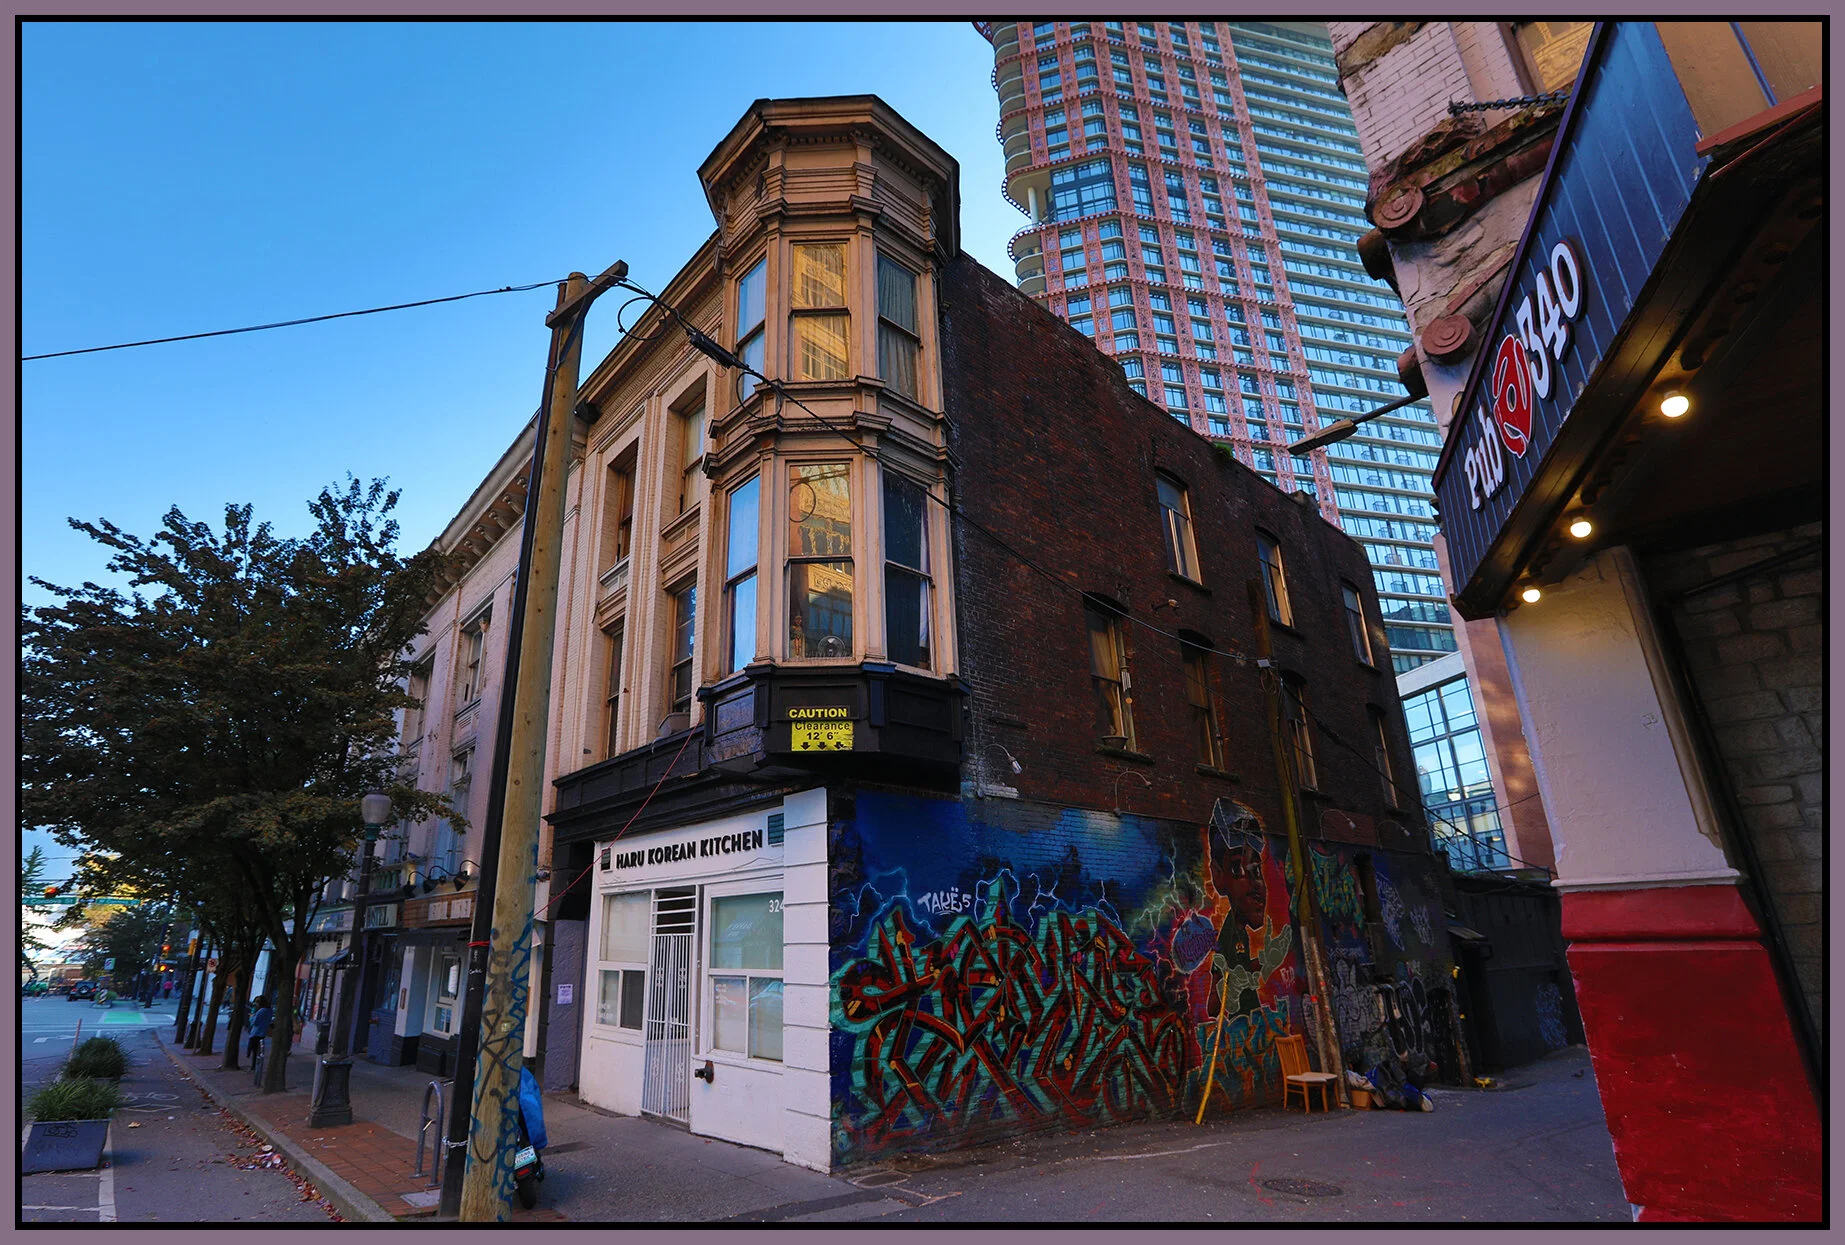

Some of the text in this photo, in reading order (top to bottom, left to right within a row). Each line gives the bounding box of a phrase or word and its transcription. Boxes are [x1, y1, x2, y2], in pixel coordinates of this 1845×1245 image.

[1516, 242, 1580, 399] 340
[789, 708, 847, 718] CAUTION
[795, 721, 850, 730] Clearance
[616, 829, 763, 869] HARU KOREAN KITCHEN
